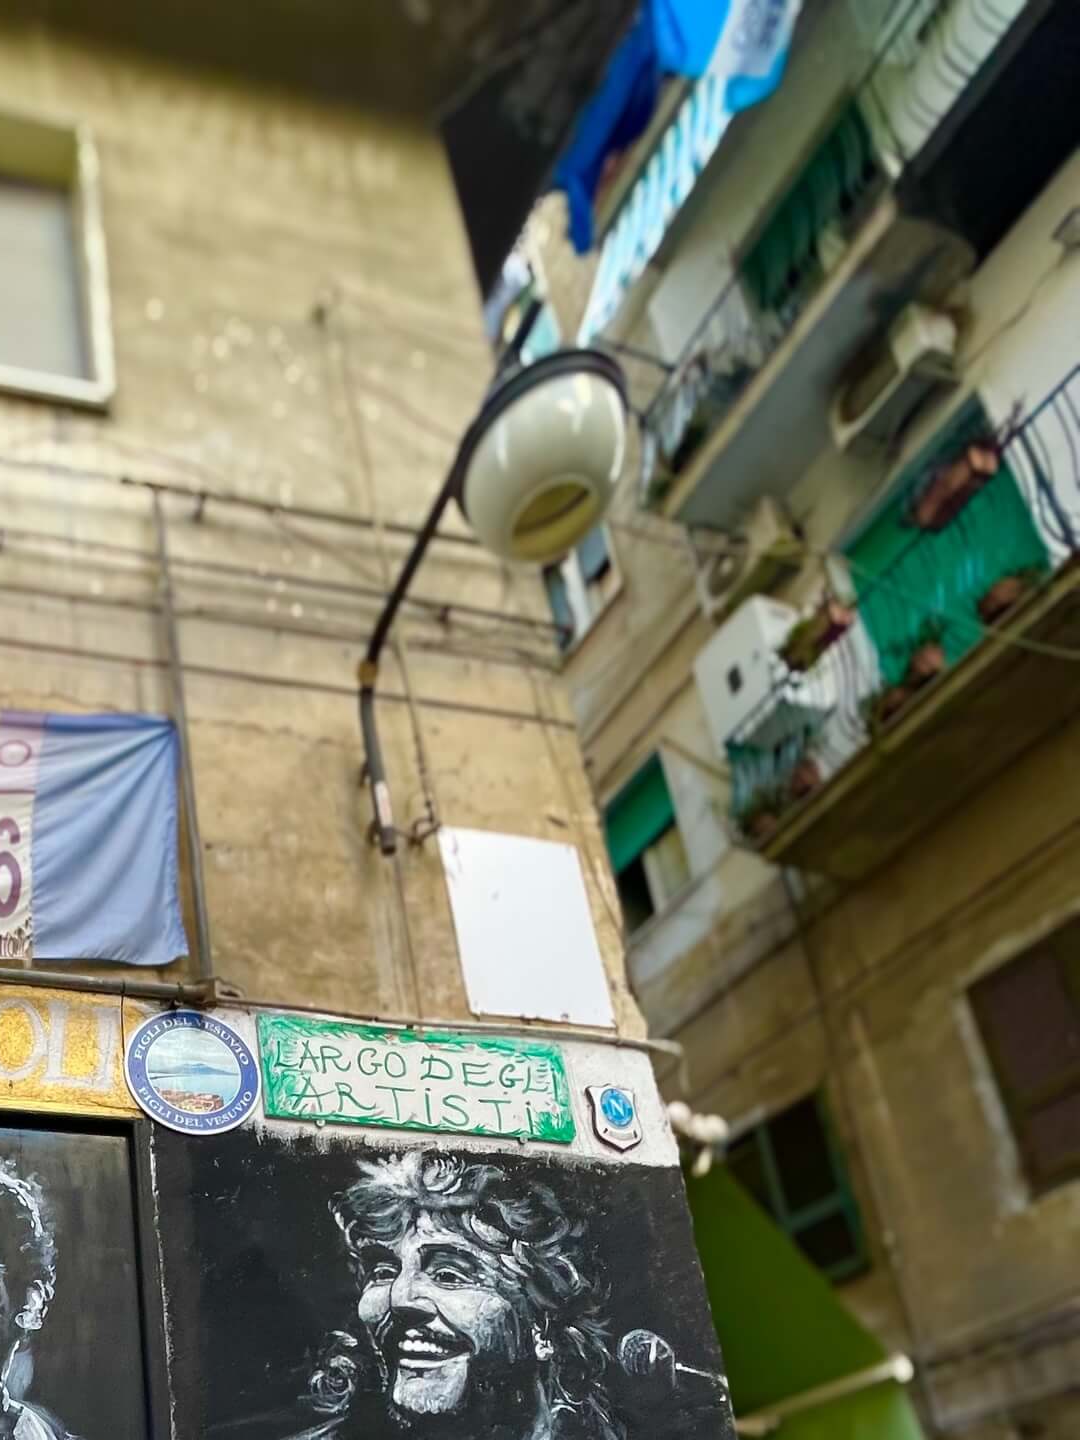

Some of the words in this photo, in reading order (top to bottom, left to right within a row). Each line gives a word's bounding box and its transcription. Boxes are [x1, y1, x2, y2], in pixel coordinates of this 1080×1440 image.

[134, 1026, 161, 1061] FIGLI
[162, 1016, 193, 1029] DEL
[195, 1018, 250, 1067] VESUVIO
[273, 1039, 408, 1079] LARGO
[138, 1086, 172, 1121] FIGLI
[175, 1114, 204, 1128] DEL
[205, 1090, 253, 1128] VESUVIO
